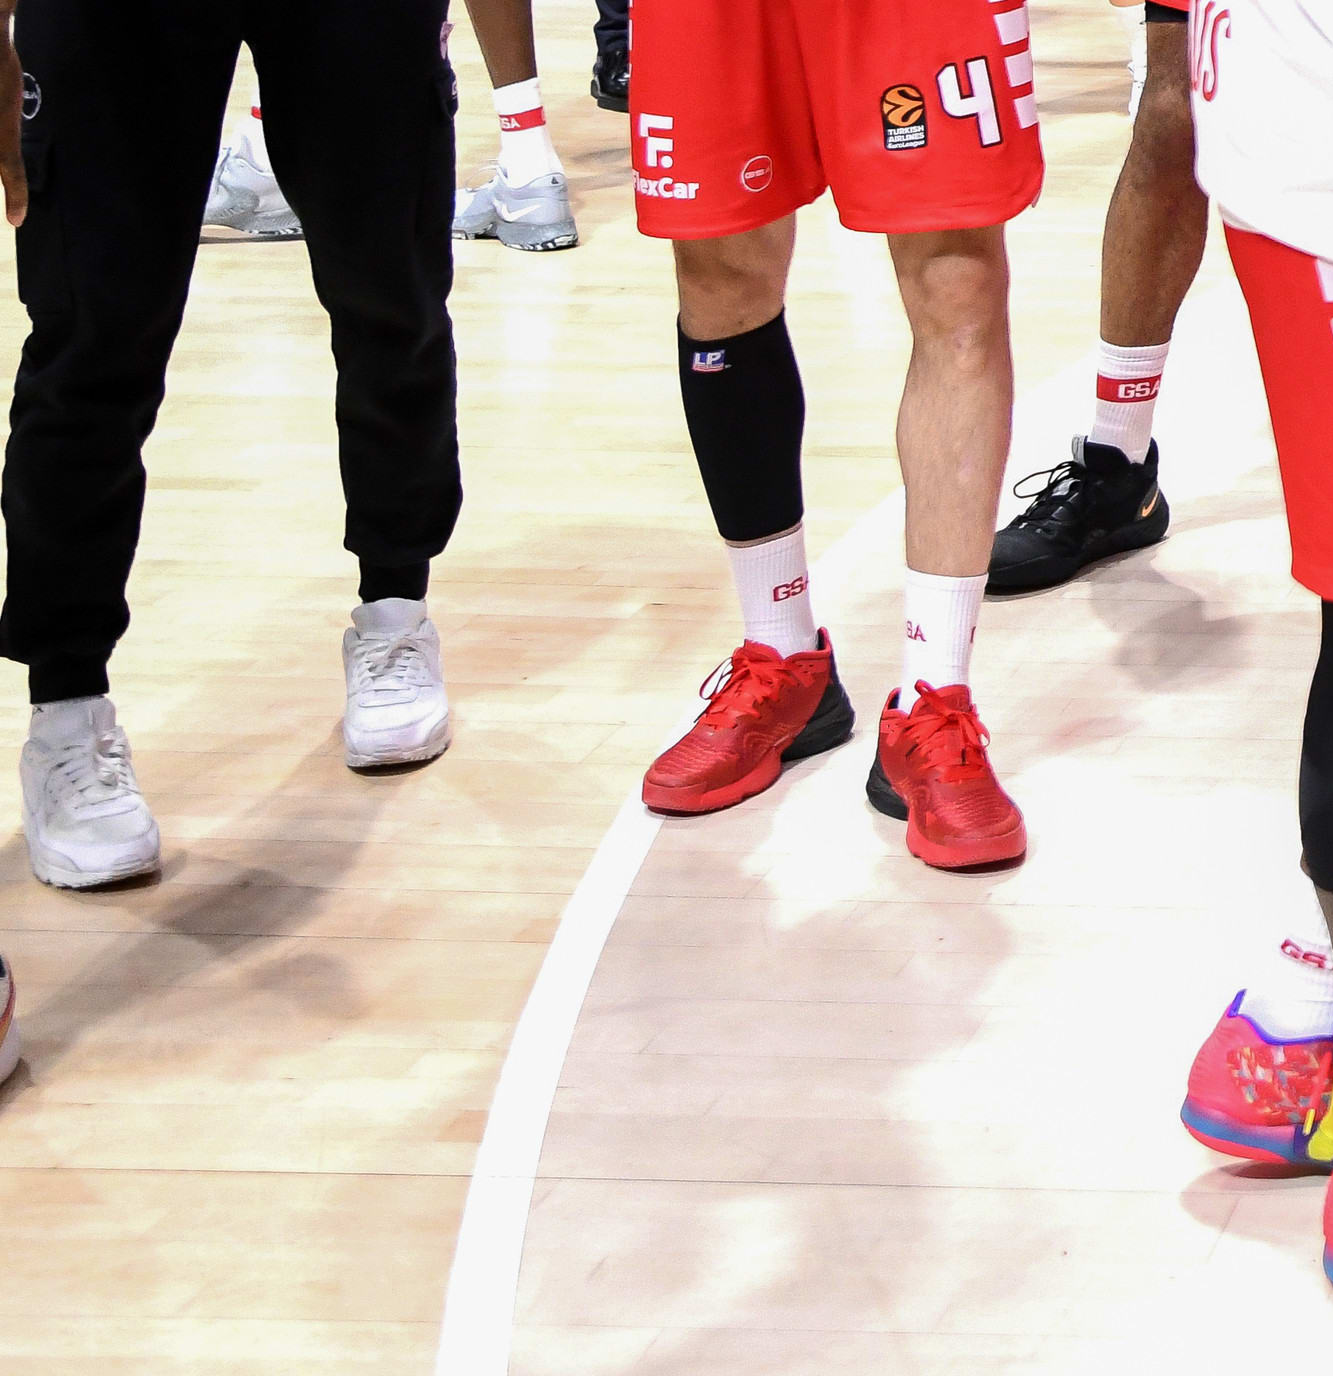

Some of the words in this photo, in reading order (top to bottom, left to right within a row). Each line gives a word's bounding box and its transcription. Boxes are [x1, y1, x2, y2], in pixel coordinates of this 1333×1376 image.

[936, 56, 1003, 148] 4
[888, 125, 924, 135] TURKISH
[693, 351, 723, 371] LP
